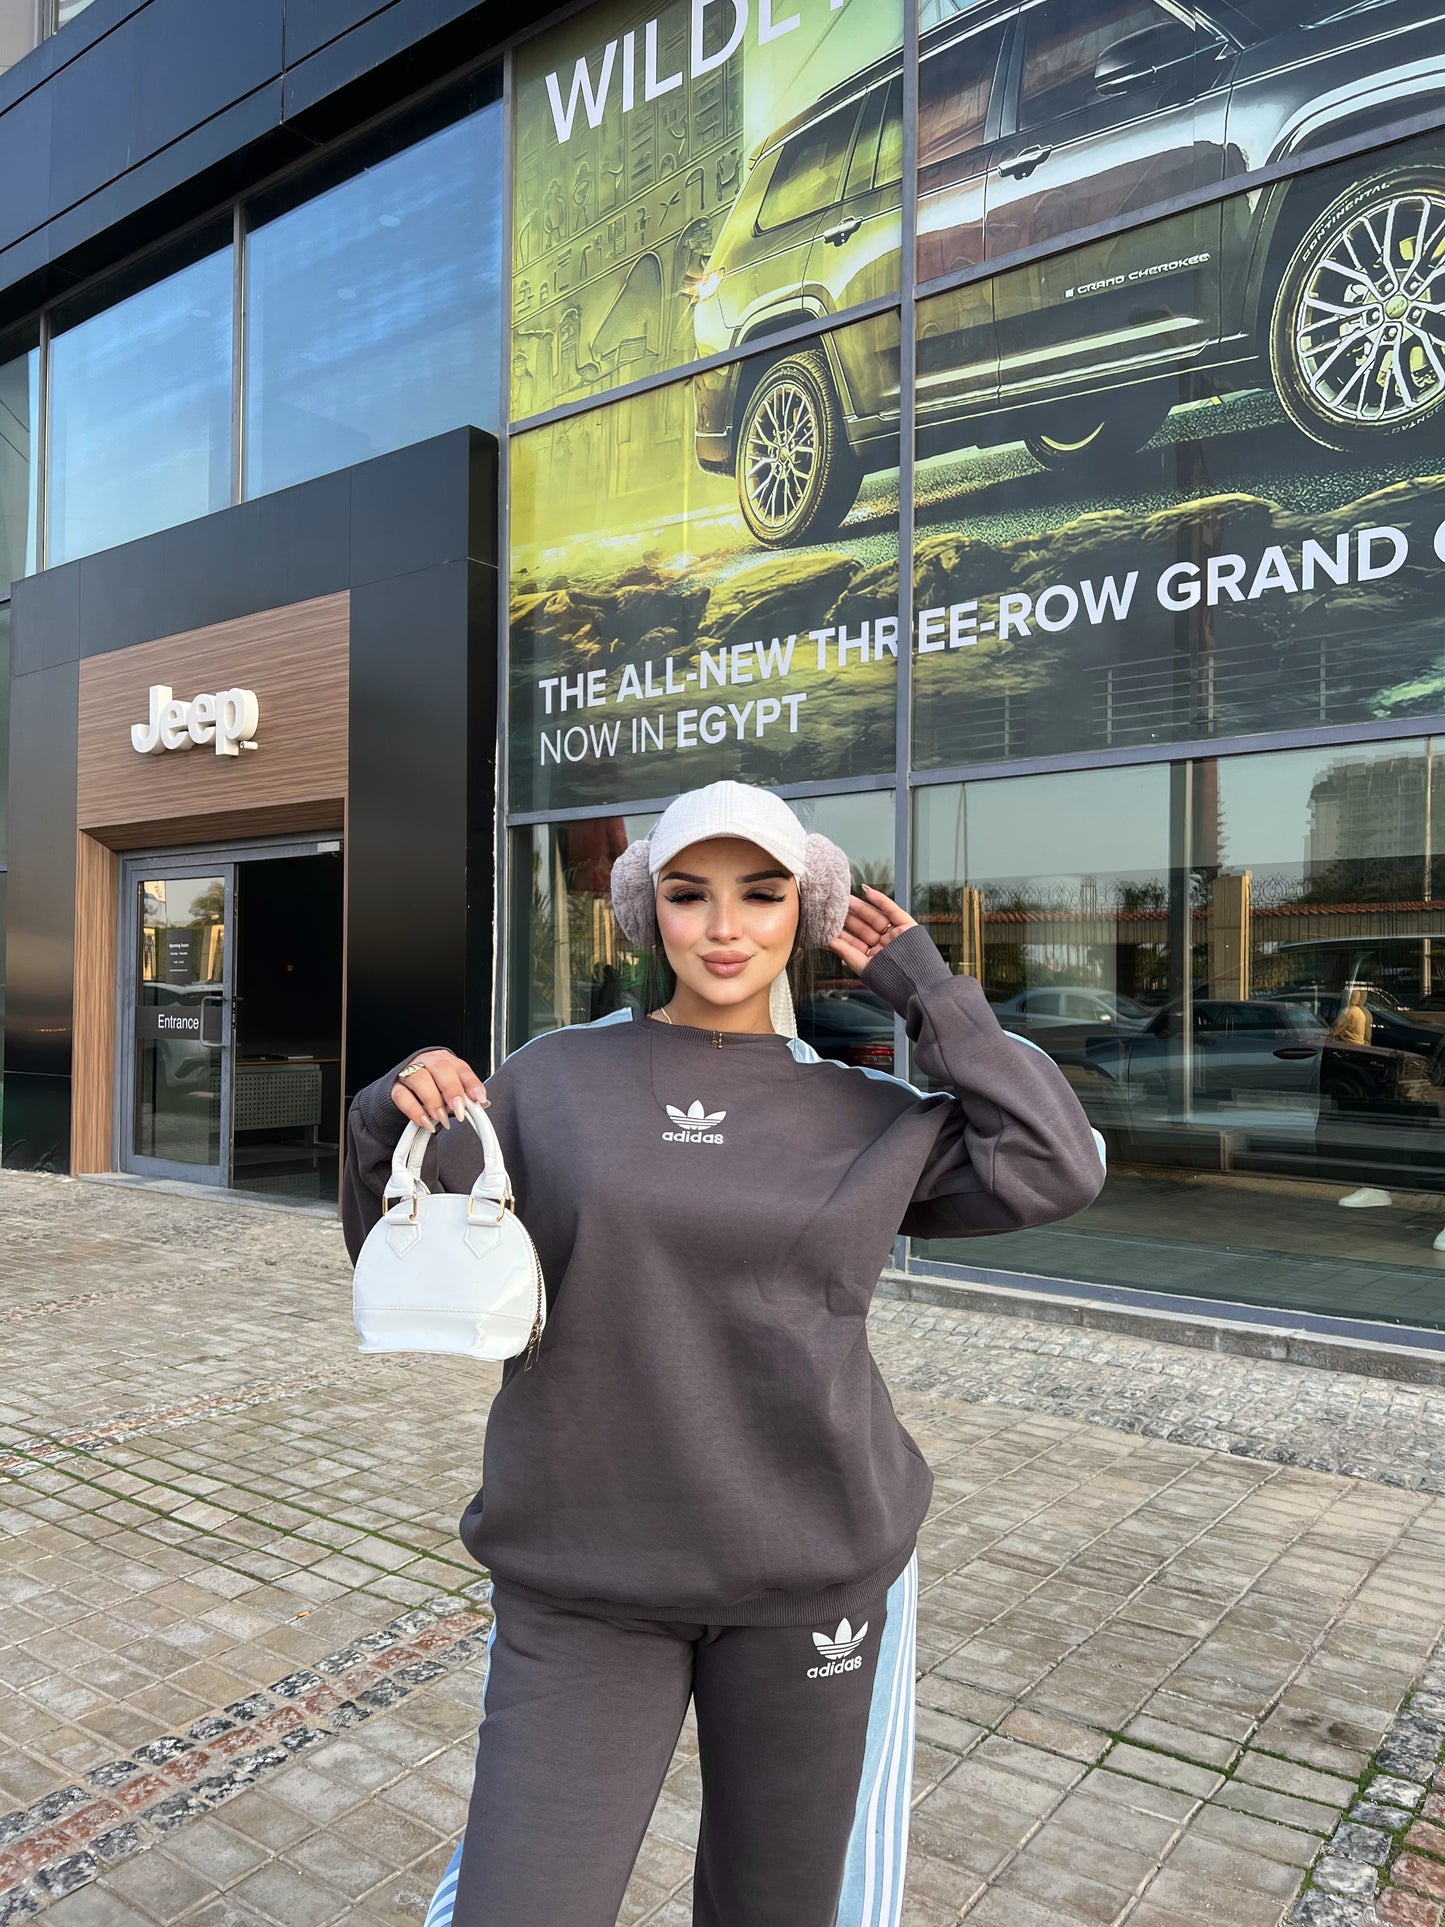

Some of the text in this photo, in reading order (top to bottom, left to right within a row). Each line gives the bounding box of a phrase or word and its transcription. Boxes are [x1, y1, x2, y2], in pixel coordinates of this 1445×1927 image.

[545, 0, 842, 144] WILD
[1077, 252, 1211, 294] GRAND CHEROKEE
[538, 669, 607, 714] THE
[616, 634, 797, 703] ALL-NEW
[808, 570, 1139, 671] THREE-ROW
[1157, 526, 1409, 612] GRAND
[131, 684, 259, 756] Jeep
[540, 693, 807, 766] NOW IN EGYPT
[157, 1013, 200, 1030] Entrance
[661, 1130, 724, 1145] adidas
[806, 1655, 862, 1679] adidas
